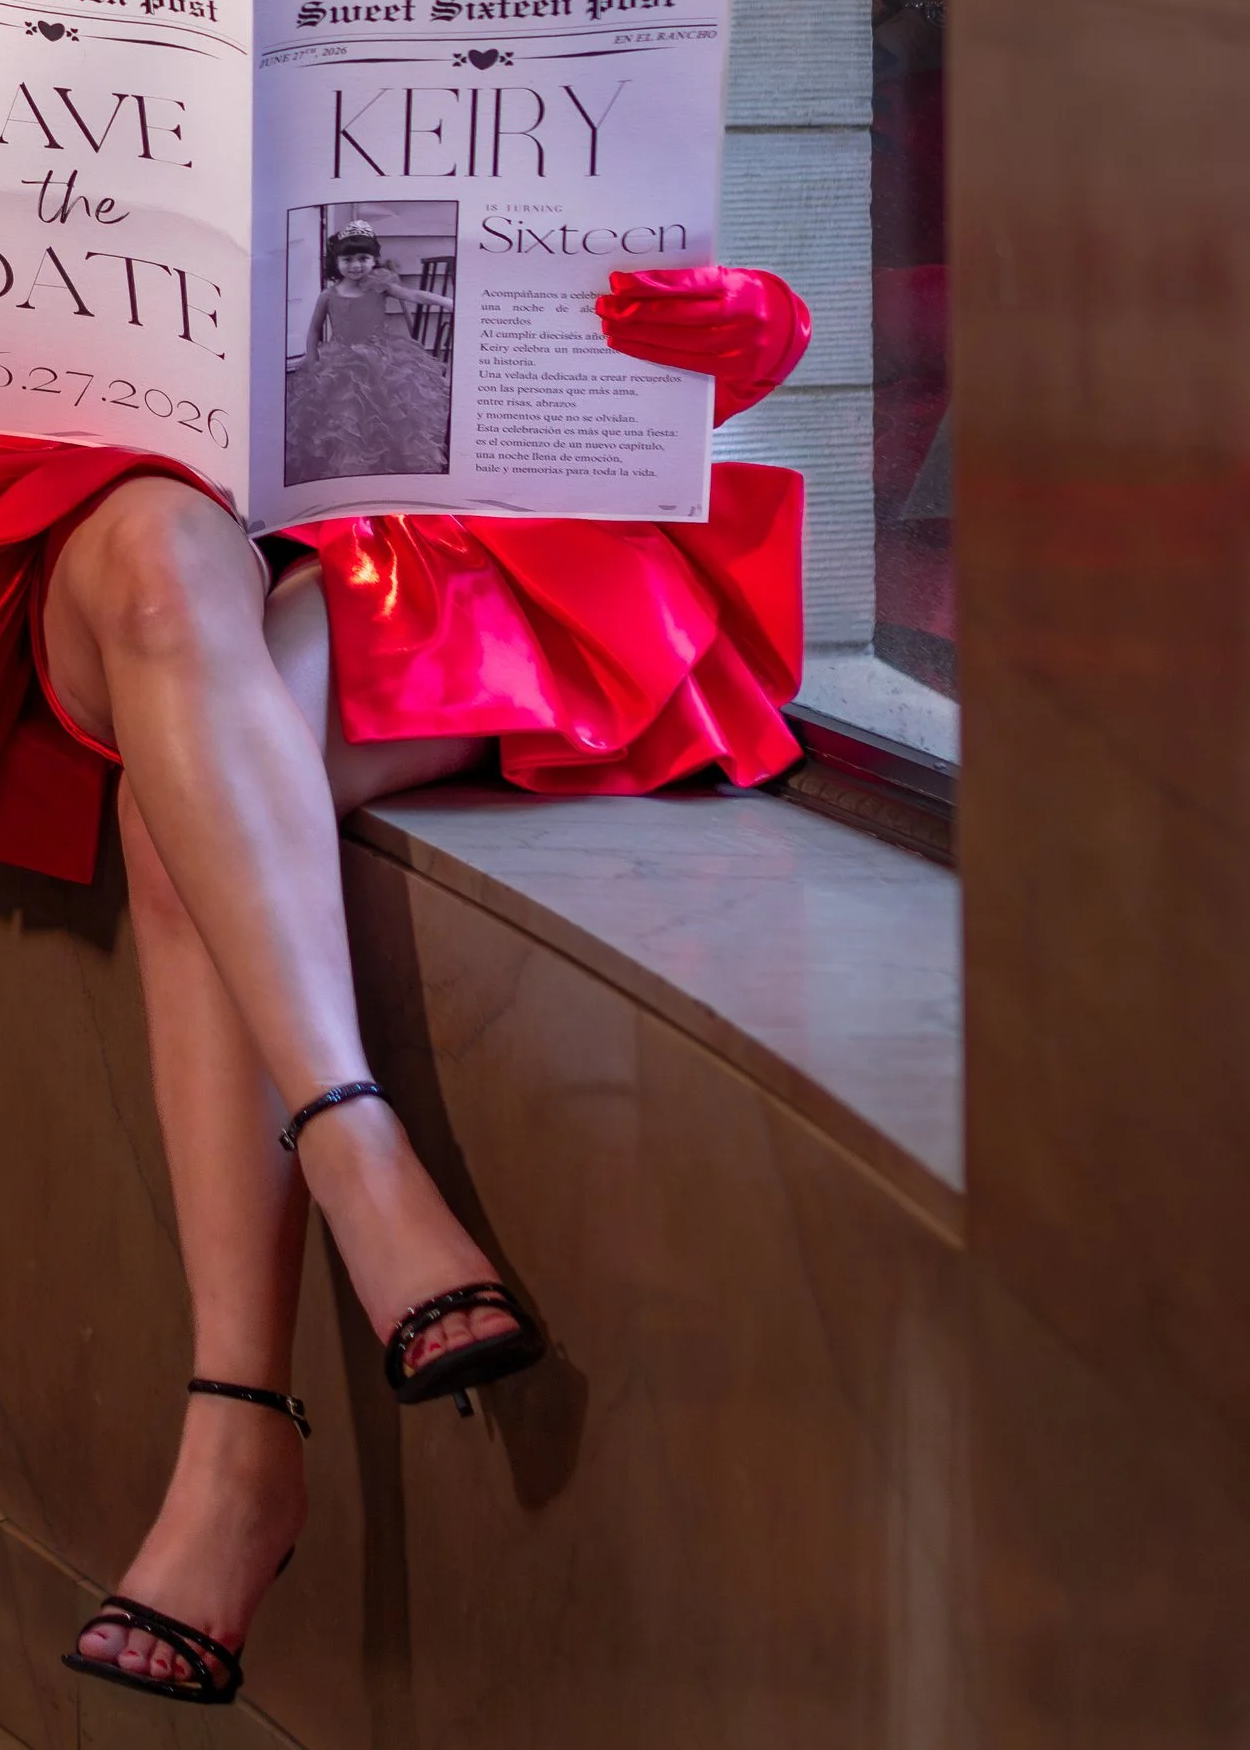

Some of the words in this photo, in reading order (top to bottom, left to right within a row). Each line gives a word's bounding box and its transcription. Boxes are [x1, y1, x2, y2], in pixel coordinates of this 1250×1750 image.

[614, 34, 635, 45] EN
[635, 32, 653, 43] EL
[656, 29, 718, 41] RANCHO
[258, 52, 292, 70] JUNE
[322, 46, 348, 57] 2026
[329, 79, 633, 181] KEIRY
[21, 169, 131, 225] the
[485, 203, 499, 212] IS
[479, 215, 687, 256] Sixteen
[512, 303, 545, 312] noche
[555, 304, 570, 313] de
[580, 305, 596, 313] ale
[480, 316, 532, 326] recuerdos
[479, 329, 493, 338] Al
[495, 330, 537, 341] cumplir
[480, 342, 510, 354] Keiry
[513, 344, 551, 354] celebra
[479, 358, 491, 366] su
[478, 369, 501, 379] Una
[505, 370, 538, 381] velada
[541, 371, 588, 382] dedicada
[600, 375, 627, 383] crear
[630, 374, 682, 384] recuerdos
[477, 385, 497, 393] con
[500, 384, 515, 393] las
[517, 386, 564, 397] personas
[566, 388, 586, 397] que
[477, 398, 507, 407] entre
[536, 399, 577, 409] abrazos
[477, 412, 484, 421] y
[486, 412, 542, 421] momentos
[543, 413, 564, 423] que
[566, 414, 580, 422] no
[582, 415, 593, 423] se
[477, 423, 500, 433] Esta
[601, 428, 622, 438] que
[624, 429, 644, 437] una
[476, 438, 487, 446] es
[488, 437, 498, 446] el
[500, 438, 551, 448] comienzo
[553, 439, 566, 449] de
[569, 441, 583, 449] un
[585, 442, 617, 450] nuevo
[476, 452, 496, 460] una
[498, 452, 530, 461] noche
[532, 452, 557, 462] llena
[559, 453, 573, 462] de
[475, 463, 501, 473] baile
[502, 466, 509, 475] y
[511, 465, 564, 475] memorias
[565, 467, 590, 477] para
[593, 467, 617, 476] toda
[619, 467, 629, 476] la
